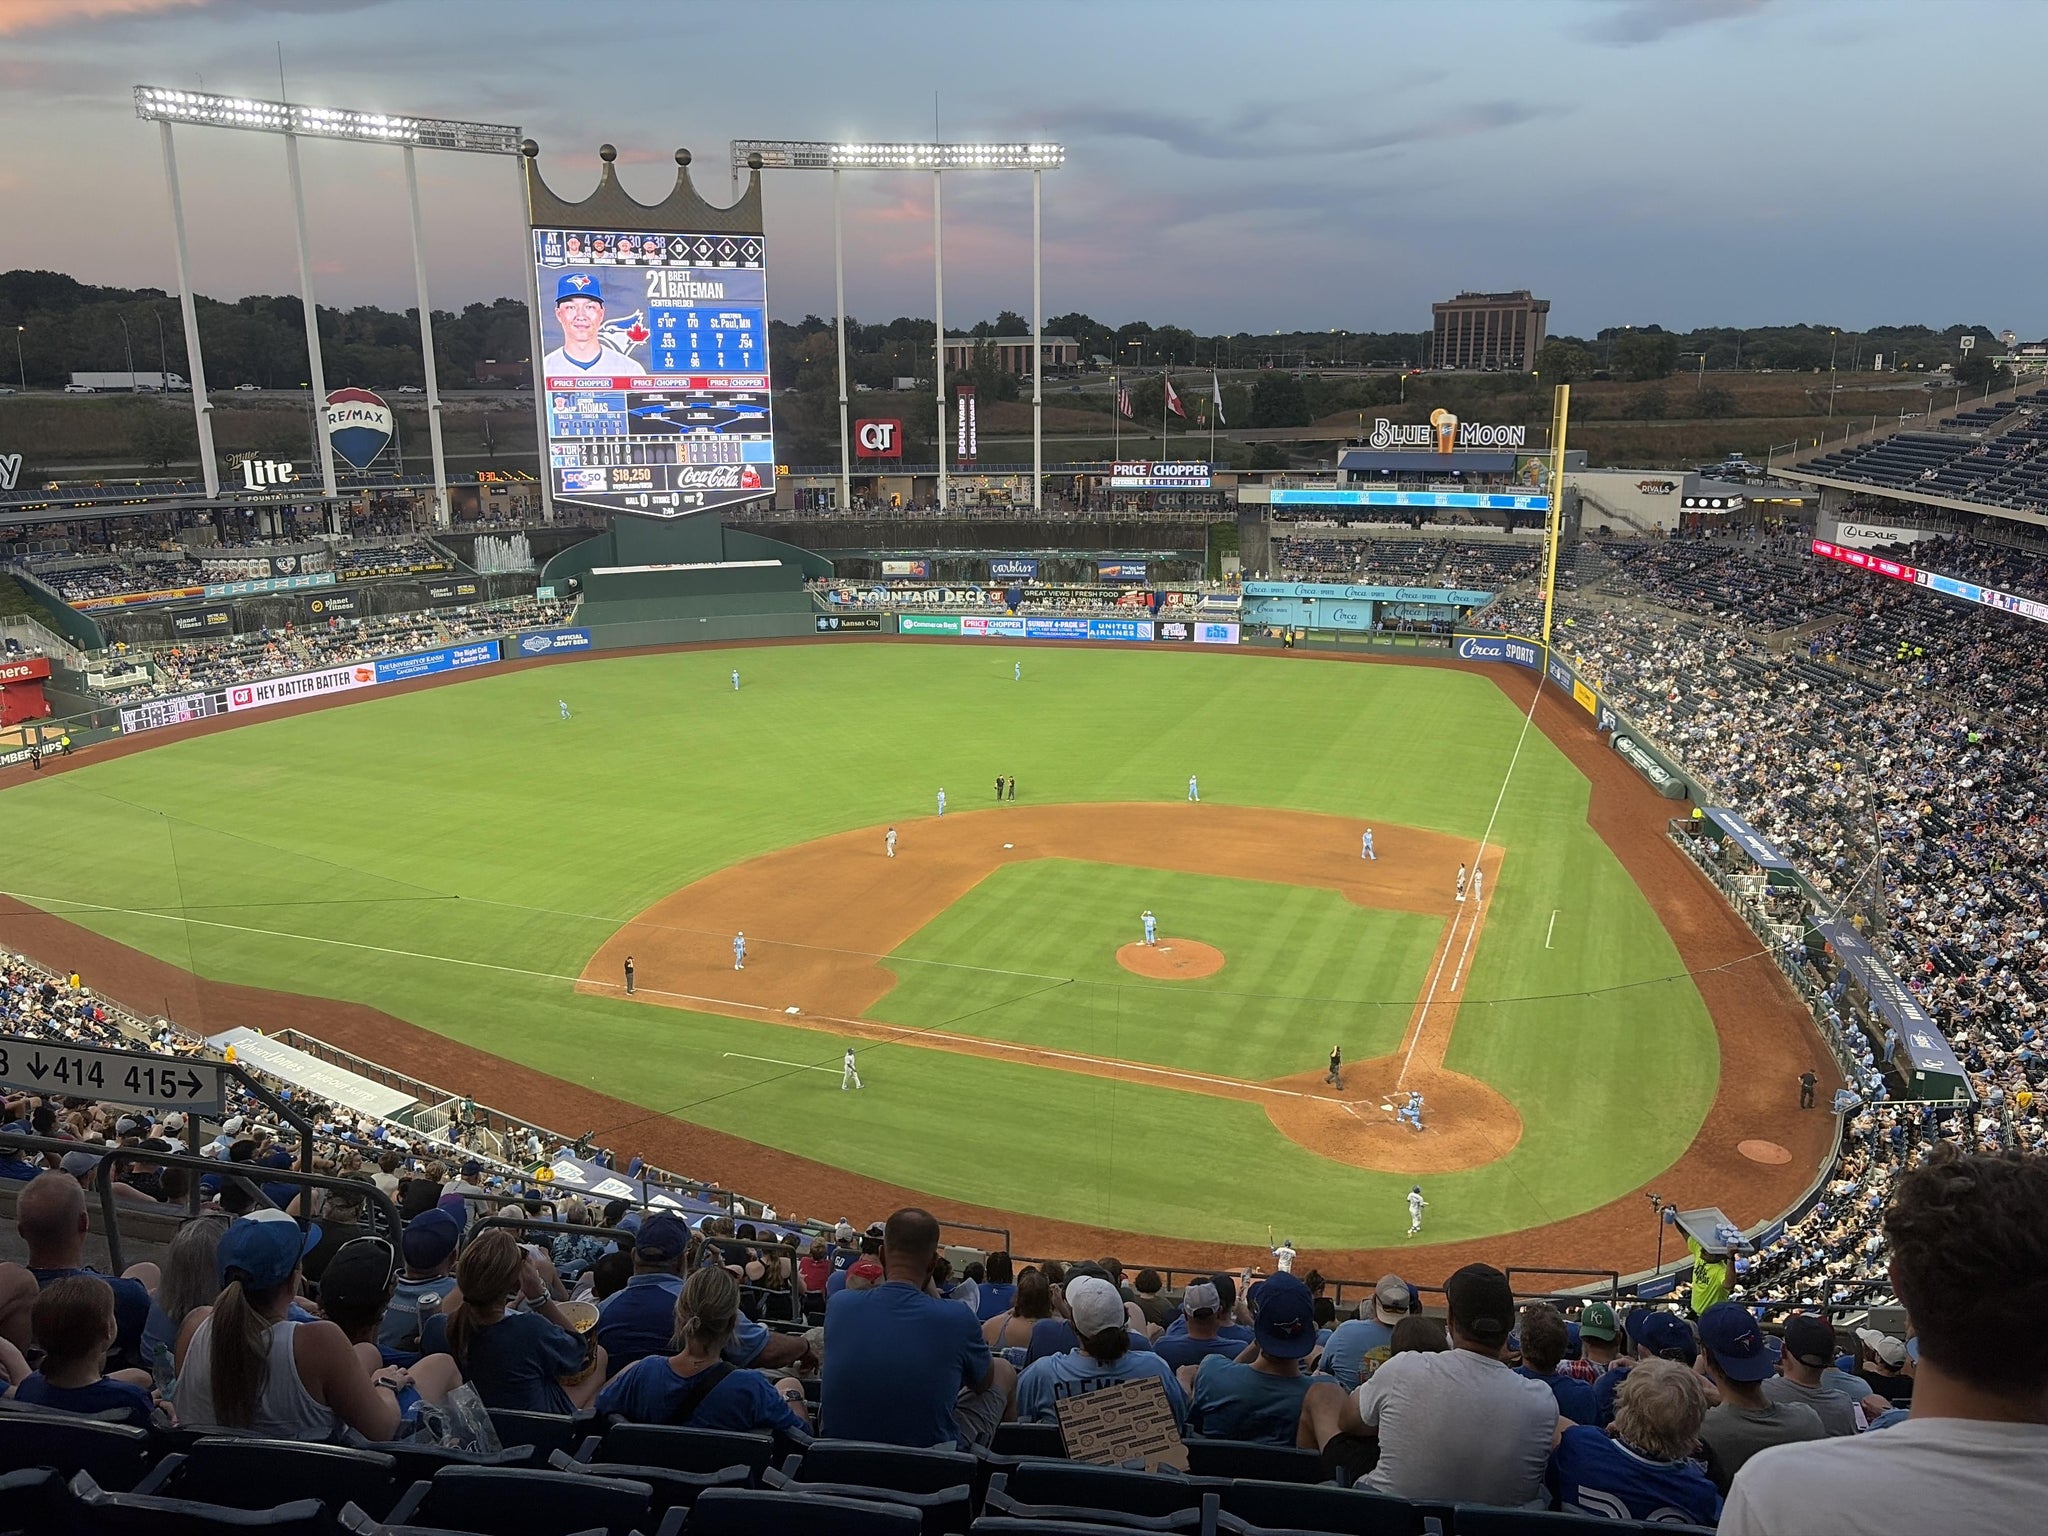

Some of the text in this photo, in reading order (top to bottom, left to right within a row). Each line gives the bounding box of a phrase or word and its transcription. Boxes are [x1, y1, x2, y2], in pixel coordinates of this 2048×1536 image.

[547, 233, 666, 249] AT 4 27 30 38
[545, 245, 561, 256] BAT
[646, 270, 691, 298] 21 BRETT
[668, 282, 724, 299] BATEMAN
[651, 299, 694, 308] CENTER FIELDER
[687, 318, 699, 328] 170
[710, 318, 720, 328] St.
[721, 318, 739, 329] Paul,
[740, 319, 751, 328] MN
[661, 338, 676, 348] .333
[664, 358, 700, 367] 32 96
[578, 403, 609, 413] THOMAS
[327, 409, 384, 425] RE/MAX
[958, 398, 966, 455] BOULEVARD
[859, 423, 895, 451] QT
[1370, 418, 1526, 449] BLUE MOON
[562, 443, 728, 455] TOR 2 0 1 0 0 3 10 0 5 3
[225, 450, 260, 471] Miller
[564, 454, 697, 467] KC 2 0 0 1 0 3 4
[241, 460, 294, 492] Lite
[479, 471, 496, 482] 0:30
[613, 466, 742, 488] $18,250 Coca-Cola
[1113, 465, 1209, 476] PRICE CHOPPER
[1641, 485, 1670, 493] RIVALS
[247, 493, 289, 502] FOUNTAIN
[625, 492, 704, 507] BALL 0 STRIKE 0 OUT 2
[1858, 530, 1898, 541] LEXUS
[992, 560, 1035, 574] carbliss
[858, 591, 1002, 603] FOUNTAIN DECK QT
[1245, 583, 1266, 595] Circa
[1294, 584, 1317, 596] Circa
[1344, 586, 1368, 597] Circa
[1395, 588, 1418, 600] Circa
[1447, 591, 1470, 603] Circa
[324, 597, 350, 609] planet
[1168, 594, 1180, 604] QT
[328, 601, 354, 612] fitness
[1394, 604, 1421, 618] Circa
[175, 616, 197, 626] planet
[1334, 608, 1358, 622] Circa
[841, 619, 865, 627] Kansas
[865, 619, 880, 628] City
[966, 620, 986, 628] PRICE
[989, 620, 1021, 628] CHOPPER
[453, 650, 464, 658] The
[1459, 637, 1534, 664] Circa SPORTS
[379, 663, 390, 671] THE
[390, 657, 420, 669] UNIVERSITY
[426, 654, 445, 662] KANSAS
[256, 671, 351, 701] HEY BATTER BATTER
[234, 691, 250, 704] QT
[53, 1056, 178, 1099] 414 415
[309, 1072, 348, 1092] DUGOUT
[601, 1181, 629, 1194] 1977
[1590, 1310, 1603, 1325] KC
